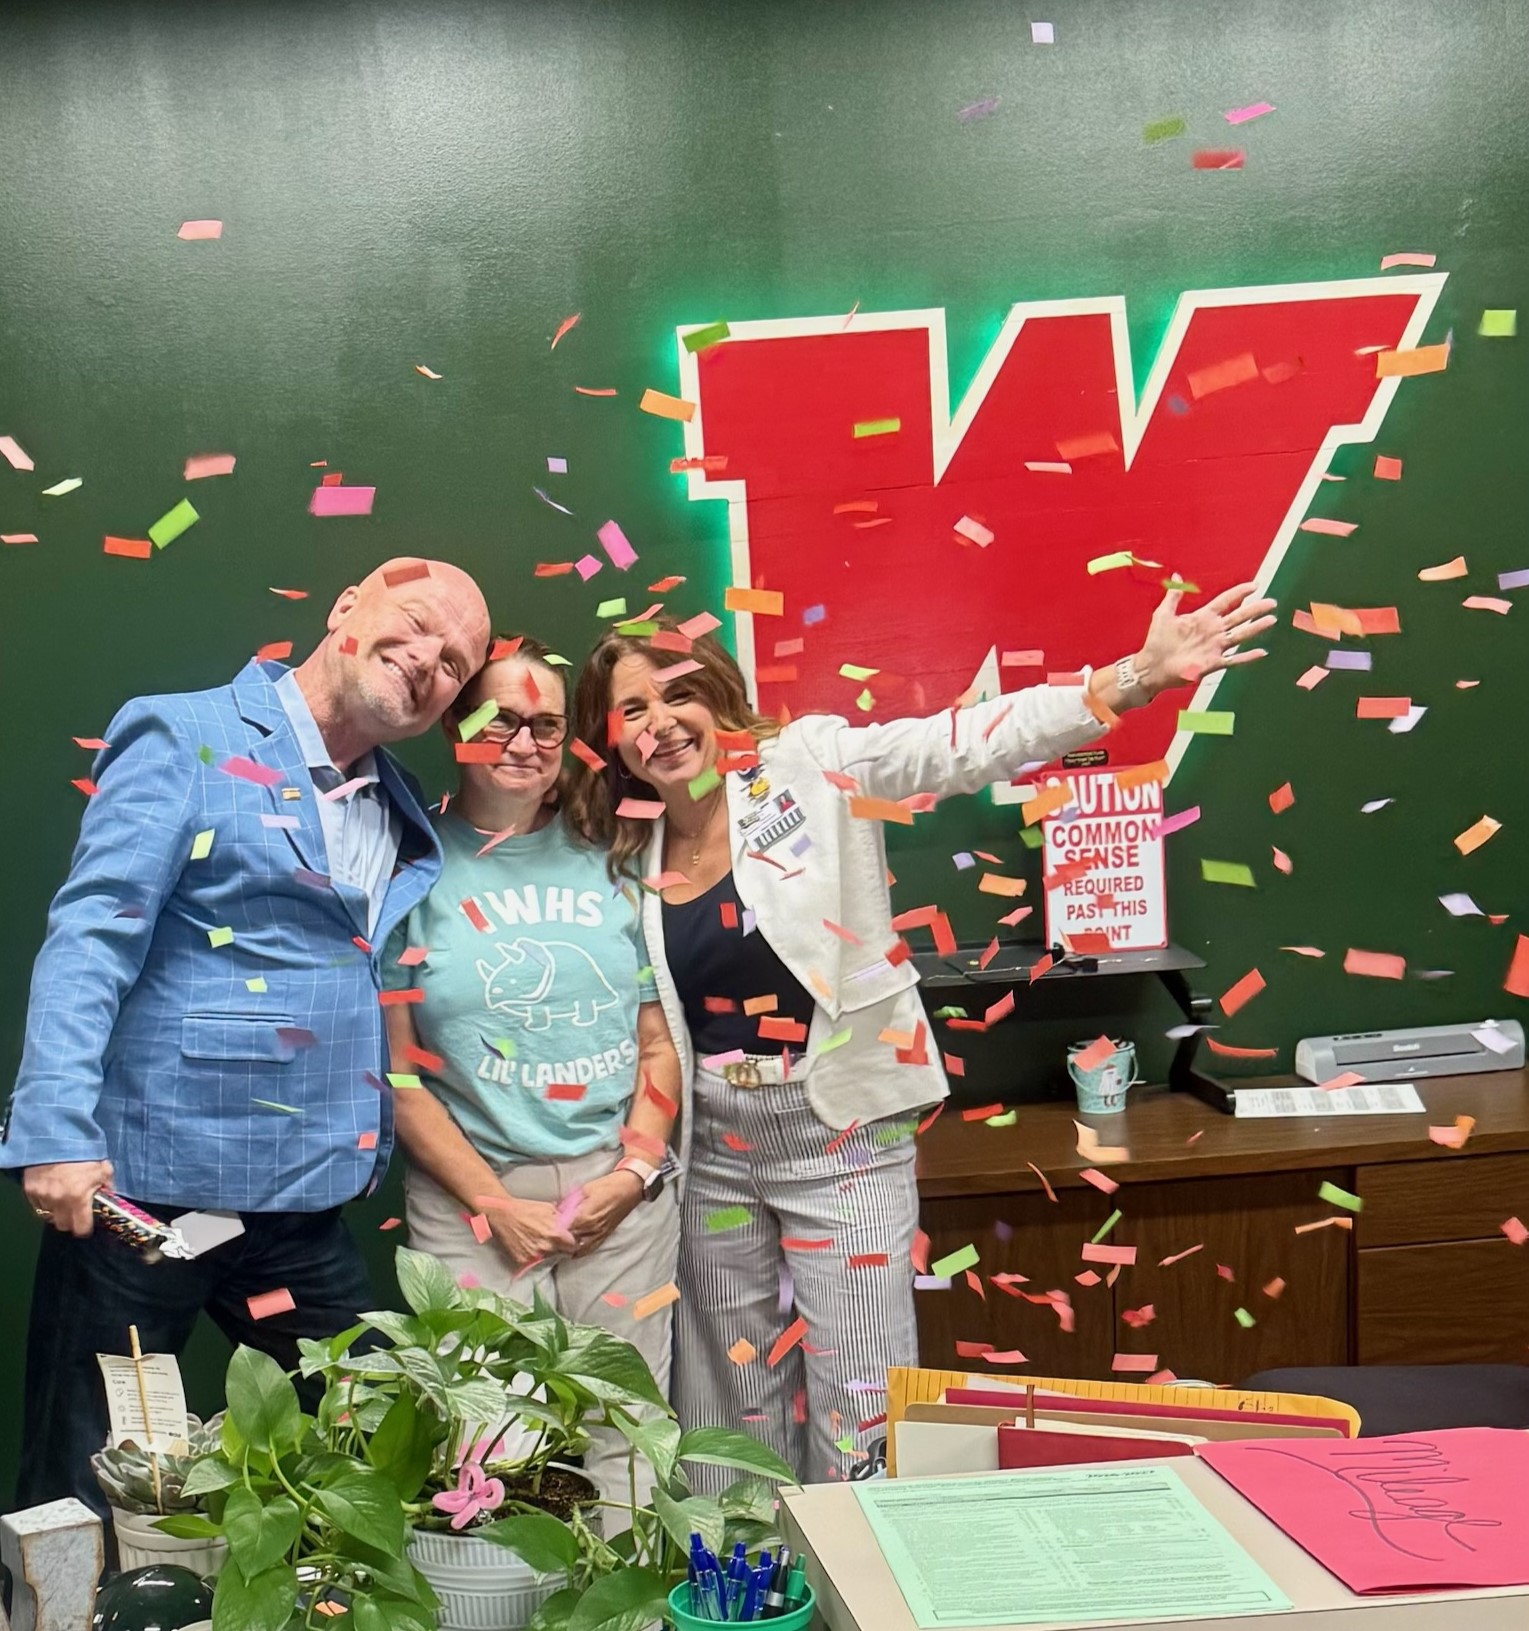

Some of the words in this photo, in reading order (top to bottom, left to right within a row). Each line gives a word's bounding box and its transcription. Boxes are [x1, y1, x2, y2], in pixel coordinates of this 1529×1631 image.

[1052, 818, 1157, 848] COMMON
[1064, 845, 1139, 870] SENSE
[1064, 876, 1144, 896] REQUIRED
[521, 1039, 636, 1088] LANDERS
